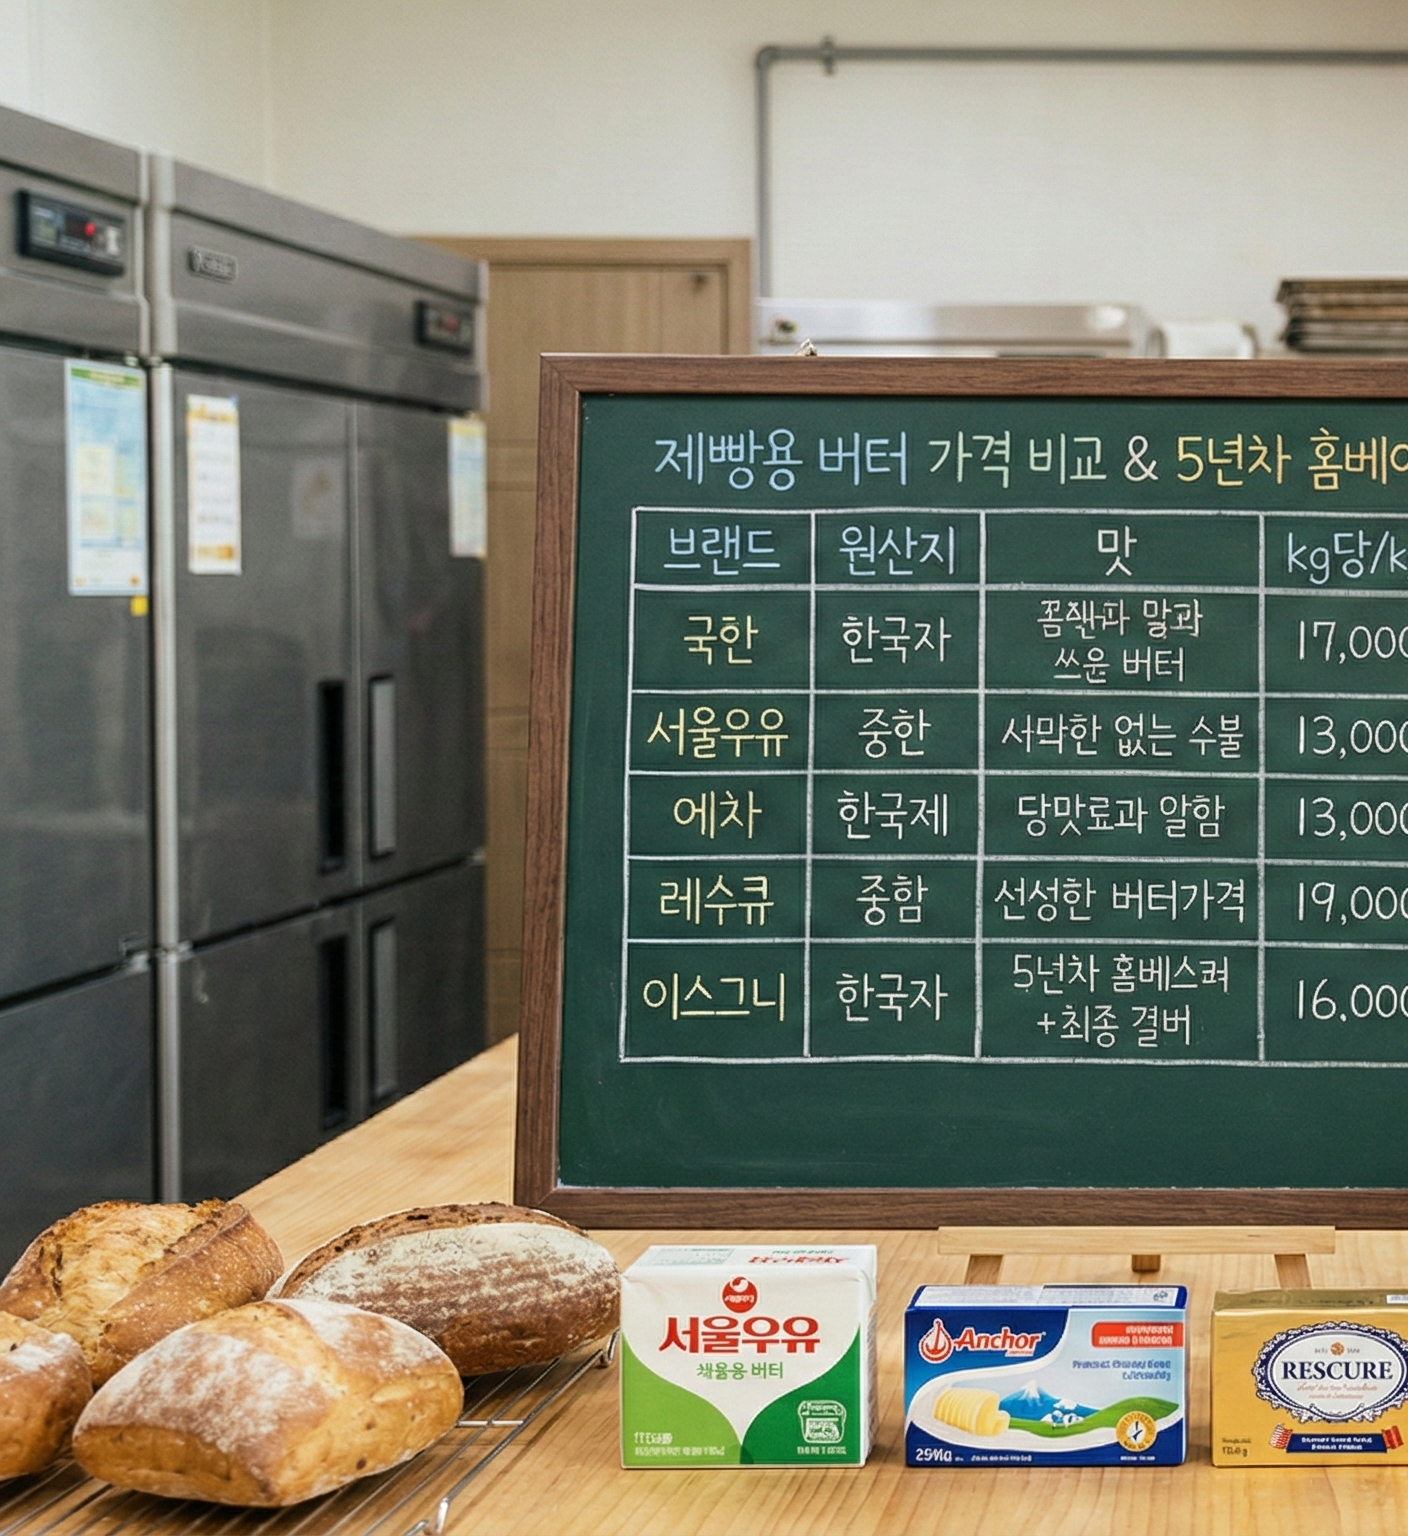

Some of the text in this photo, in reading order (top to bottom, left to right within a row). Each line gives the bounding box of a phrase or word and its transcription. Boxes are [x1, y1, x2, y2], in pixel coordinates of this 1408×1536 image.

[654, 428, 804, 491] 제빵용
[819, 431, 907, 486] 버터
[928, 430, 1011, 489] 가격
[1029, 433, 1107, 485] 비교
[1124, 435, 1159, 482] &
[1177, 433, 1292, 486] 5년차
[663, 524, 781, 576] 브랜드
[839, 525, 955, 576] 원산지
[1097, 525, 1138, 576] 맛
[683, 615, 759, 666] 국한
[842, 615, 952, 664] 한국자
[1123, 646, 1184, 682] 버터
[647, 706, 789, 759] 서울우유
[858, 708, 932, 759] 중한
[1001, 712, 1244, 759] 사막한 없는 수불
[673, 790, 763, 839] 에차
[837, 789, 948, 840] 한국제
[1159, 794, 1226, 838] 알함
[660, 874, 775, 926] 레수큐
[856, 874, 929, 926] 중함
[994, 877, 1245, 924] 선성한 버터가격
[642, 972, 785, 1022] 이스그니
[835, 972, 949, 1022] 한국자
[1013, 953, 1101, 995] 5년차
[1131, 1004, 1190, 1048] 결버
[658, 1316, 821, 1353] 서울우유
[953, 1327, 1041, 1351] Anchor
[1281, 1361, 1393, 1380] RESCURE
